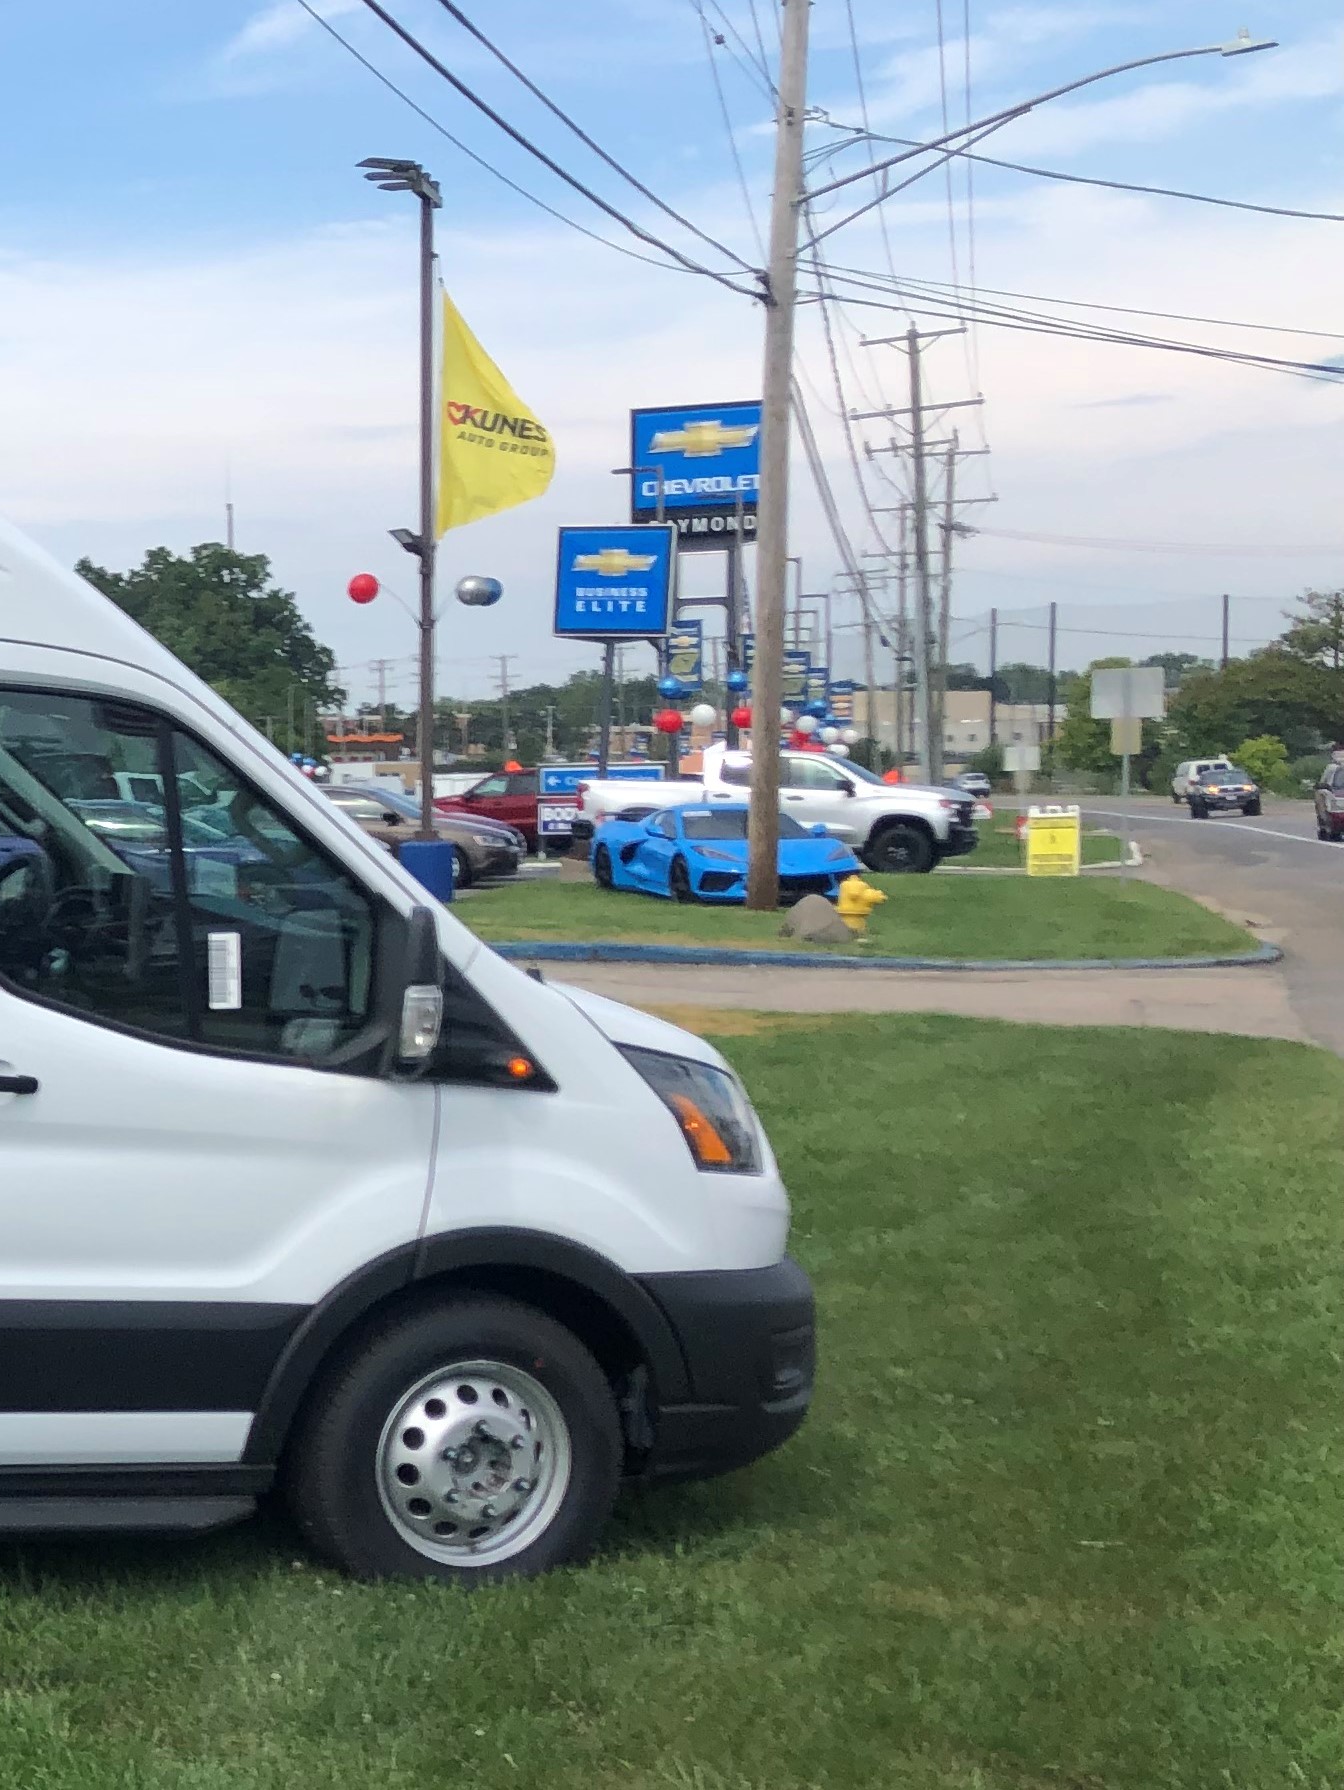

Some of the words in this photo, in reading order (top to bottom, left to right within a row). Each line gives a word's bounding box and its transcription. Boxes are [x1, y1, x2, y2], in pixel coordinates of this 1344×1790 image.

[462, 404, 548, 442] KUNES
[456, 431, 495, 448] AUTO
[499, 441, 549, 457] GROUP
[575, 600, 647, 612] ELITE
